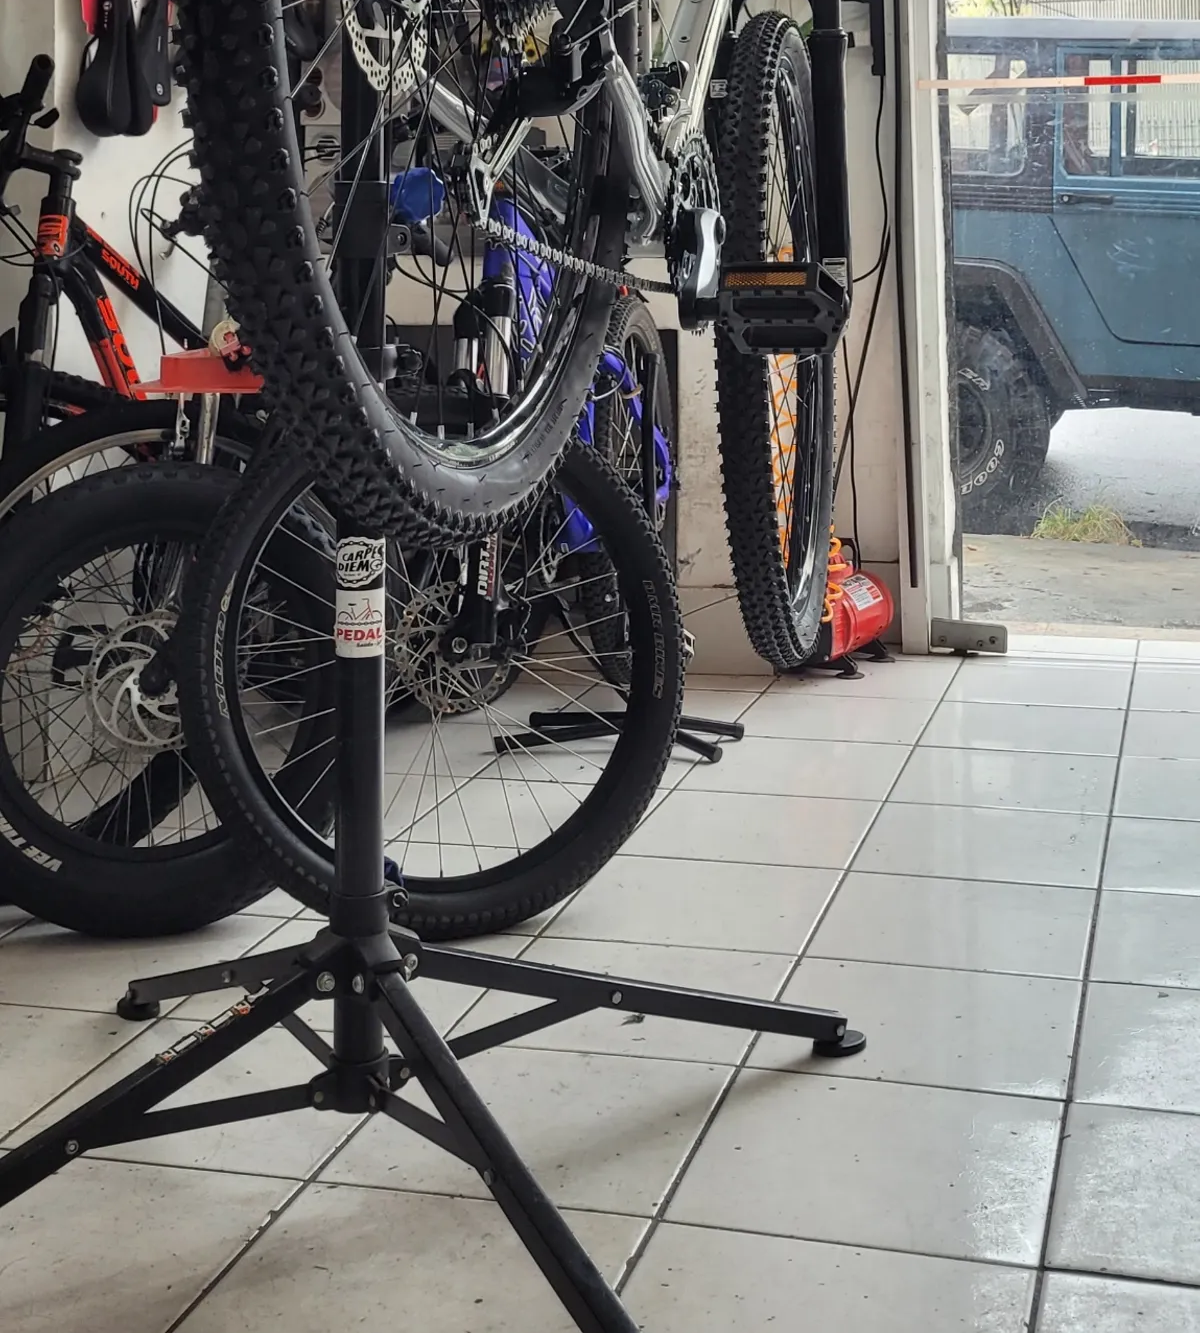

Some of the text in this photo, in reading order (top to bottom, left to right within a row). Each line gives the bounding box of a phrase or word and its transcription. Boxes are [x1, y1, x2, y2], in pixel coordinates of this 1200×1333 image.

[102, 248, 140, 292] SOUTH
[338, 560, 370, 573] DIEM
[477, 548, 491, 596] DIRT
[652, 632, 666, 699] BIKES
[21, 845, 63, 873] VEE
